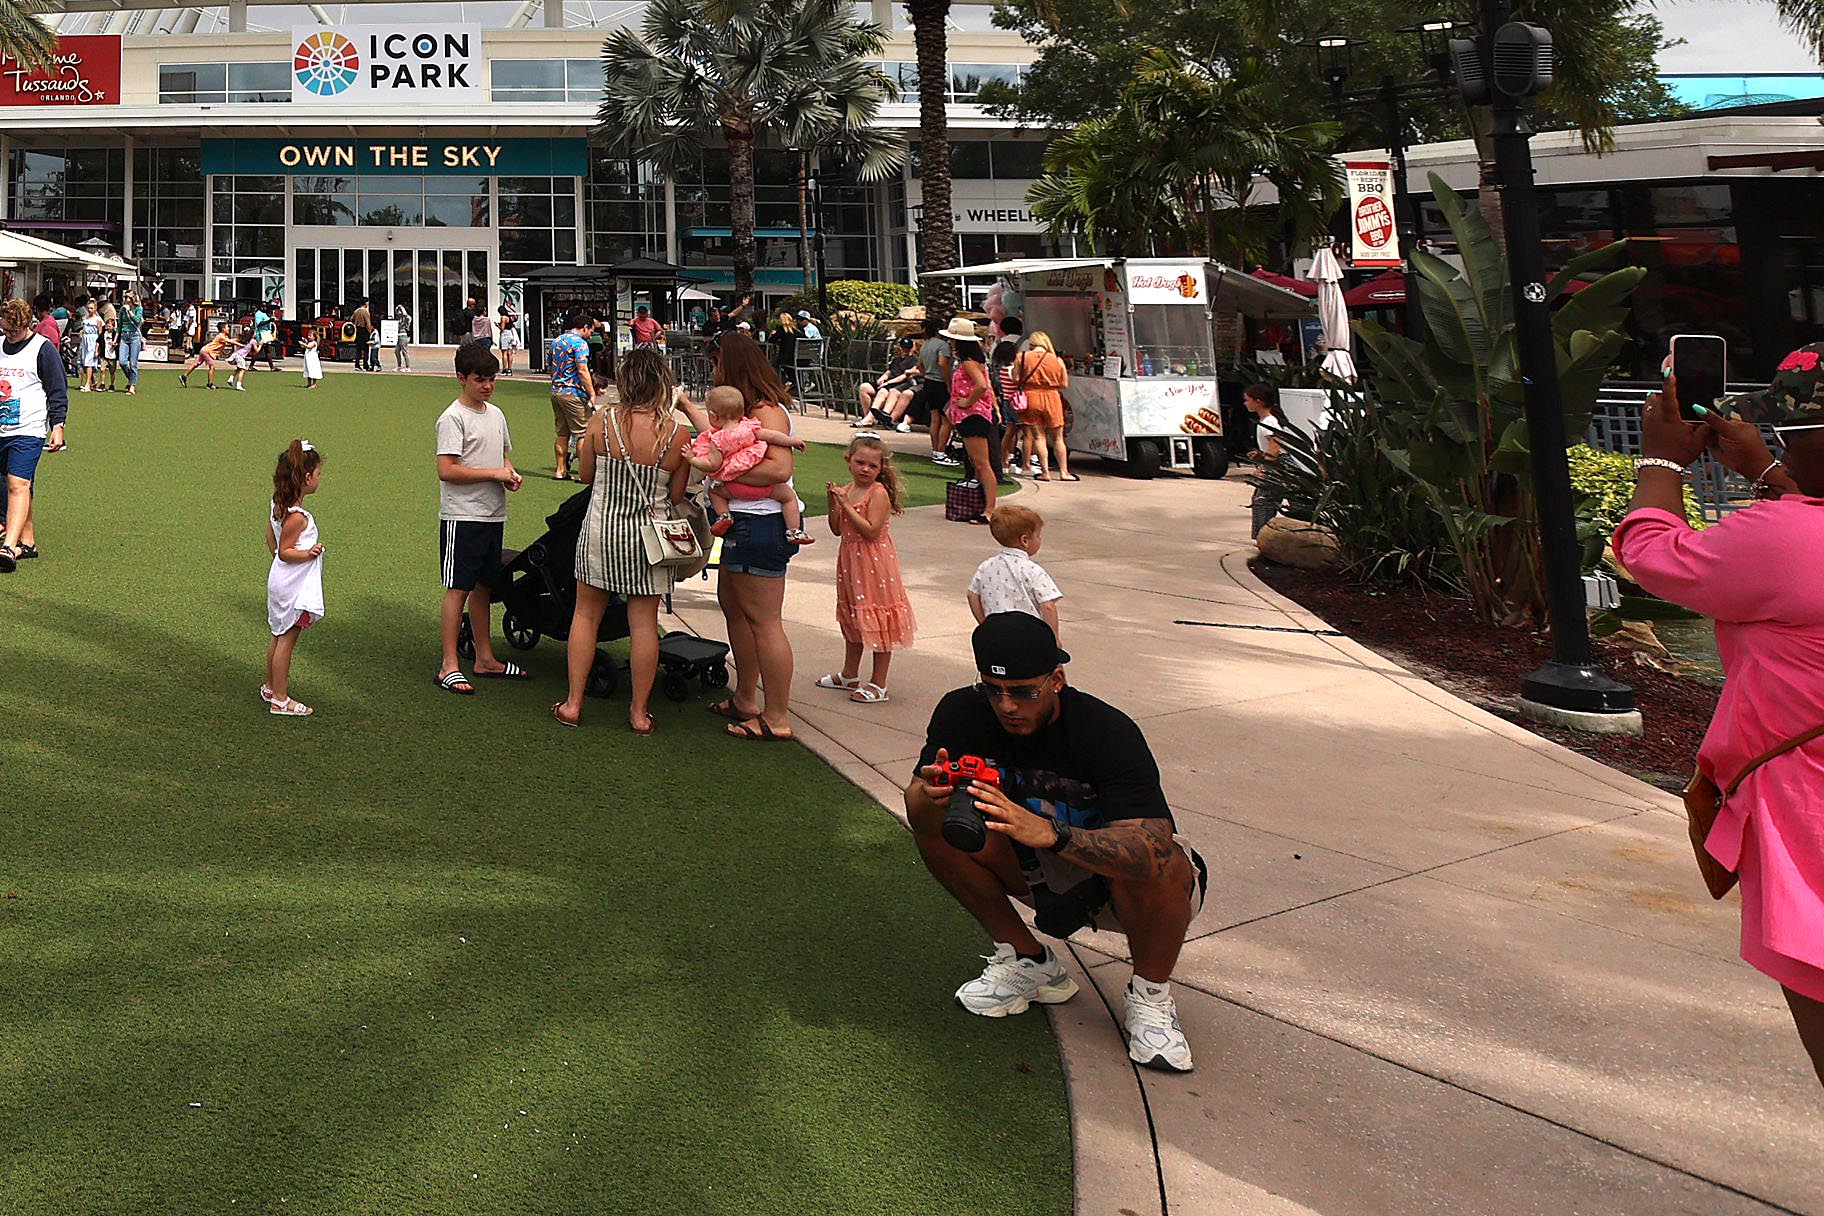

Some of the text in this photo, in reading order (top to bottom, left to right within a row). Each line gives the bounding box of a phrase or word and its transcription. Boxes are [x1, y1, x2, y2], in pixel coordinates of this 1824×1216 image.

[370, 33, 469, 59] ICON
[3, 66, 93, 102] Tussauds
[370, 63, 470, 88] PARK
[279, 145, 502, 167] OWN THE SKY
[1358, 184, 1383, 193] BBQ
[1132, 276, 1181, 291] Hot Dogs
